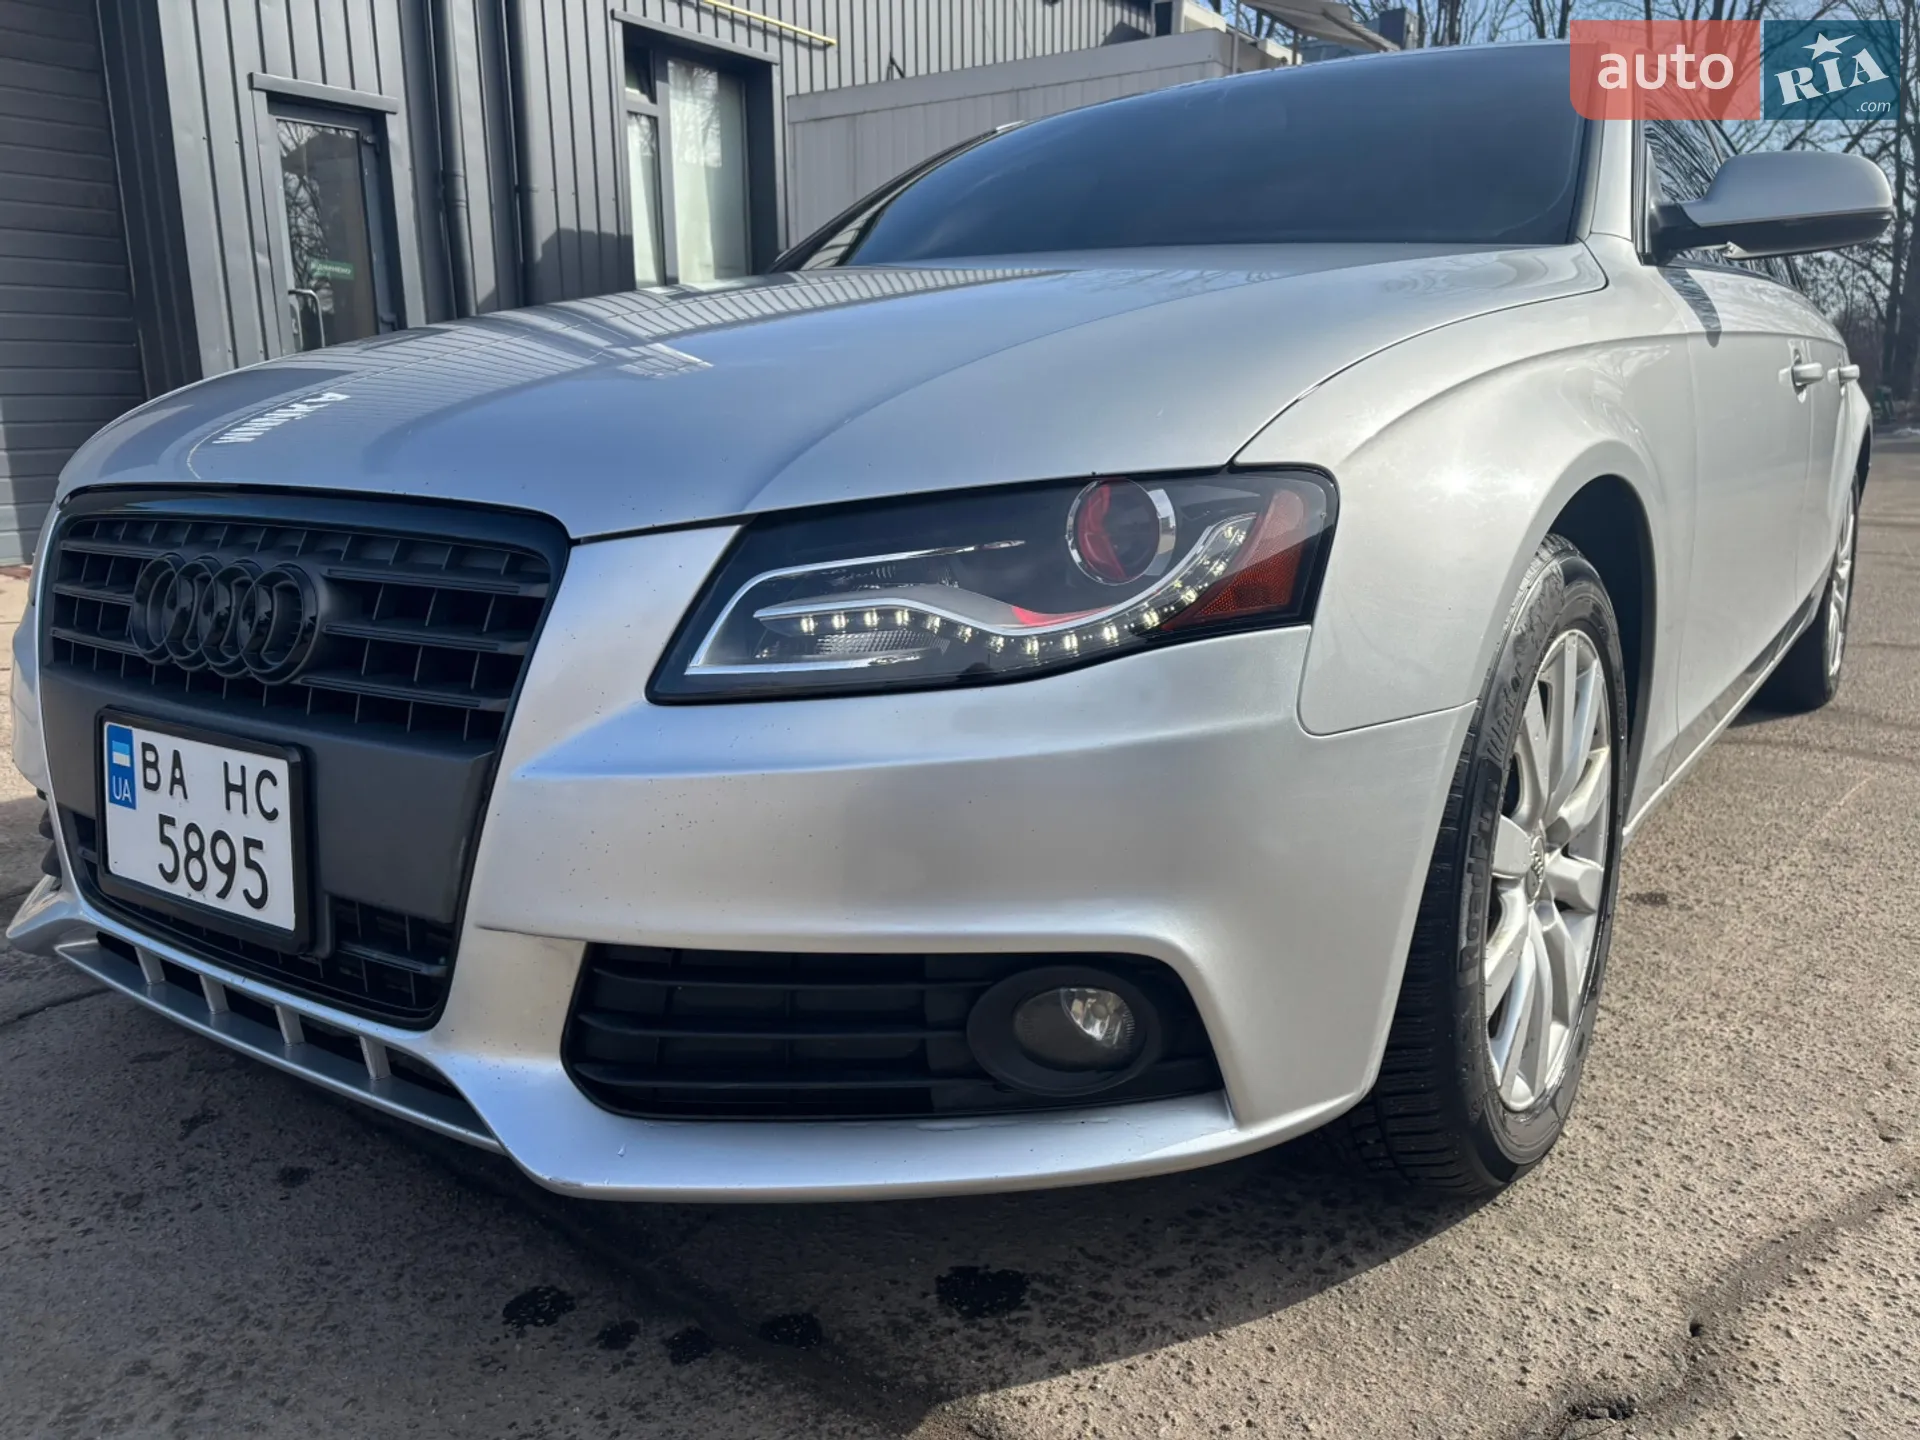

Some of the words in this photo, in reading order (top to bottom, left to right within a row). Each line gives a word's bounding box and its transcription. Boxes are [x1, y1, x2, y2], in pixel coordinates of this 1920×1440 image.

[112, 775, 132, 804] UA
[141, 741, 188, 800] BA
[223, 761, 279, 822] HC
[158, 813, 269, 911] 5895
